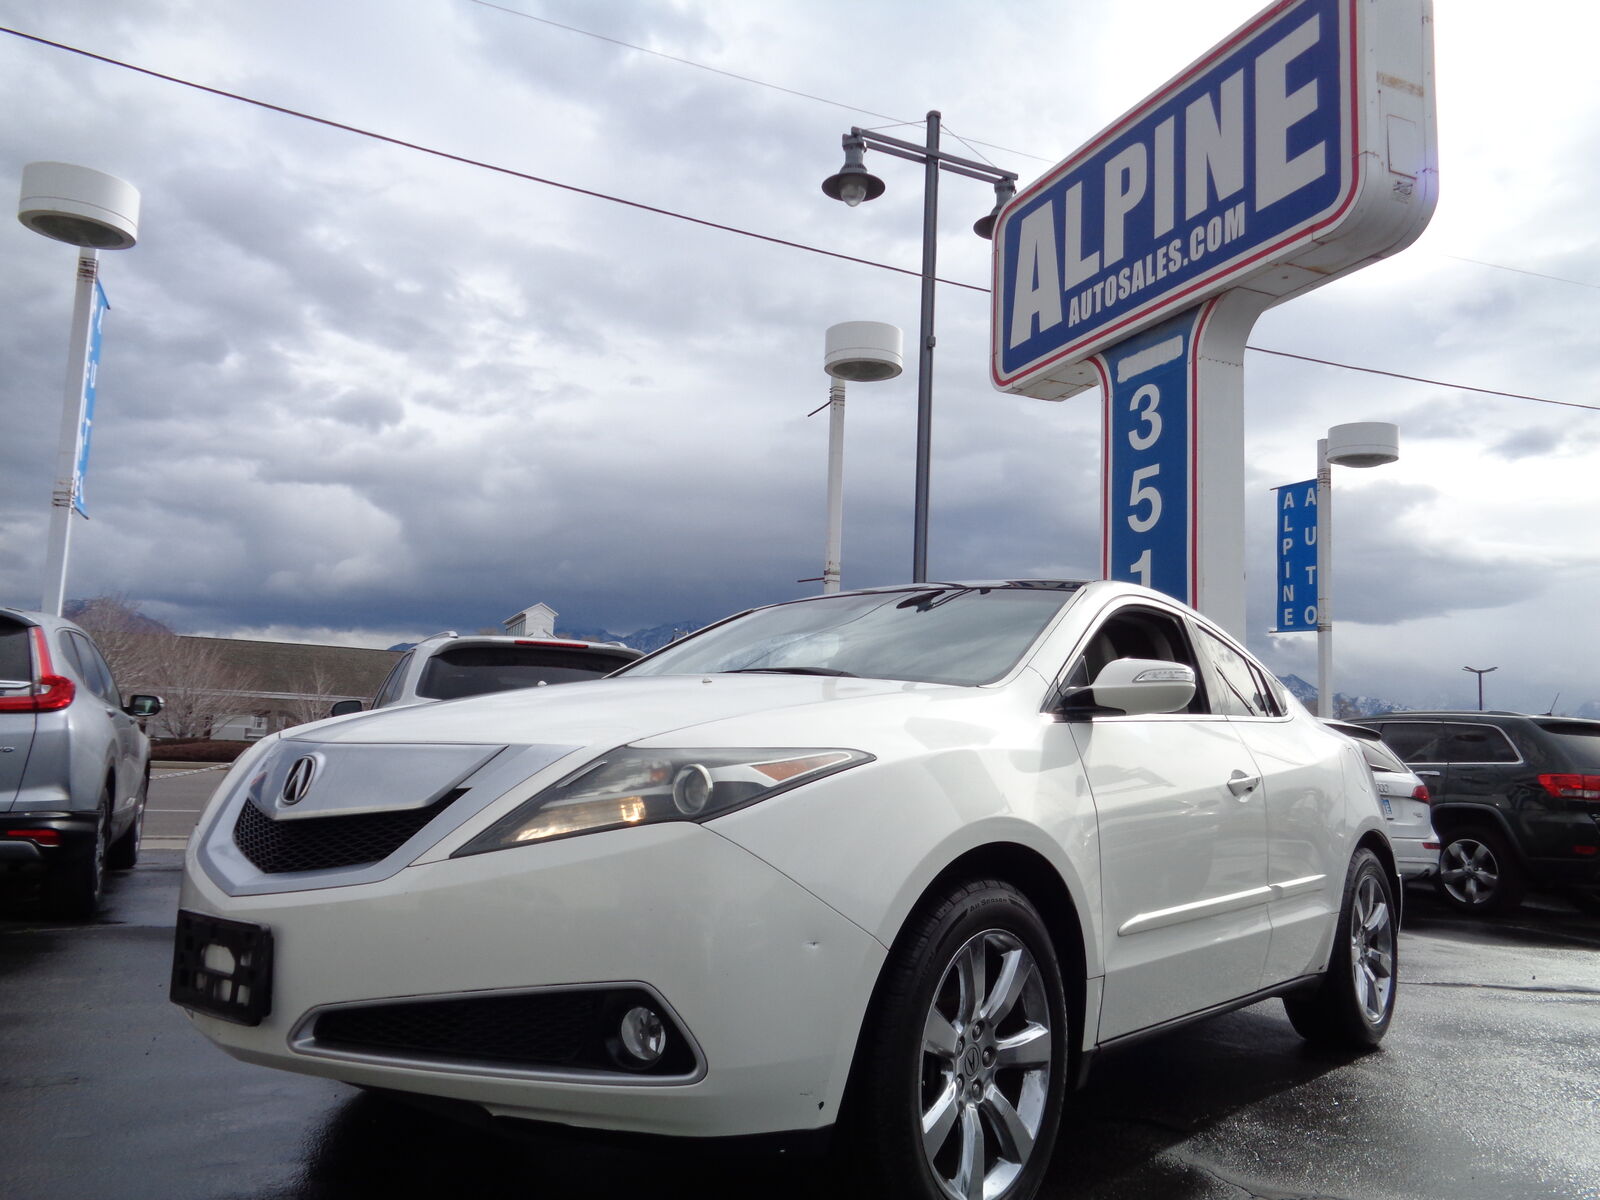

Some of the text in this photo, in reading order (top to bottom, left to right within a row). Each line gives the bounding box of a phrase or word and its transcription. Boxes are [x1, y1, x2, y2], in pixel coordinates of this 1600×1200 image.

[1010, 13, 1326, 350] ALPINE
[1068, 202, 1246, 328] AUTOSALES.COM
[1282, 491, 1295, 626] ALPINE
[1304, 487, 1318, 625] AUTO
